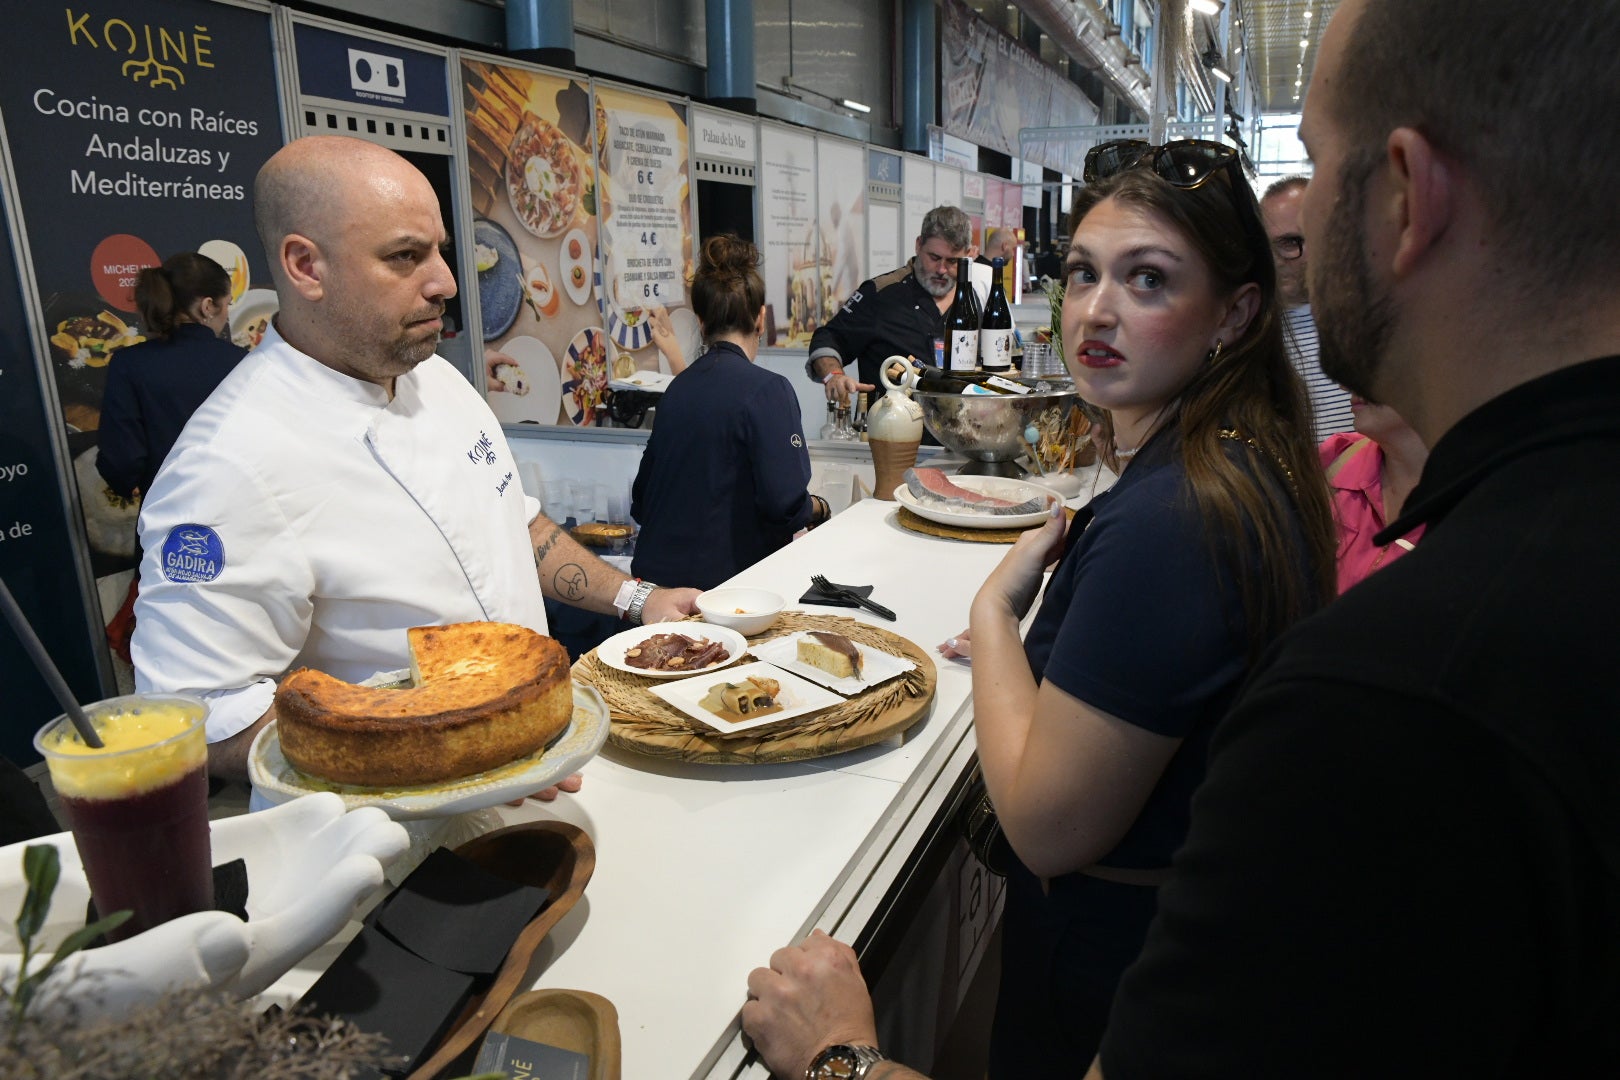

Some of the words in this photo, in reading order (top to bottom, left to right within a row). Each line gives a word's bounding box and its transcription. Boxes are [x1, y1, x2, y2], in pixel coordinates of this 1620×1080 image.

[33, 88, 129, 123] Cocina
[138, 108, 182, 129] con
[190, 107, 258, 136] Raíces
[618, 125, 629, 137] TACO
[629, 127, 635, 138] DE
[703, 128, 720, 144] Palau
[720, 132, 728, 145] de
[728, 133, 734, 146] la
[735, 135, 746, 148] Mar
[85, 133, 212, 166] Andaluzas
[217, 151, 230, 173] y
[635, 143, 652, 154] CEBOLLA
[630, 156, 643, 166] CREMA
[644, 158, 650, 167] DE
[650, 158, 662, 168] QUESO
[638, 170, 644, 184] 6
[647, 171, 653, 184] €
[70, 169, 245, 200] Mediterráneas
[637, 194, 643, 203] DE
[641, 232, 647, 245] 4
[651, 232, 656, 245] €
[627, 258, 646, 267] BROCHETA
[647, 258, 651, 266] DE
[664, 257, 672, 266] CON
[647, 271, 658, 280] SALSA
[644, 284, 650, 297] 6
[653, 284, 659, 296] €
[9, 521, 33, 539] de
[167, 551, 215, 575] GADIRA
